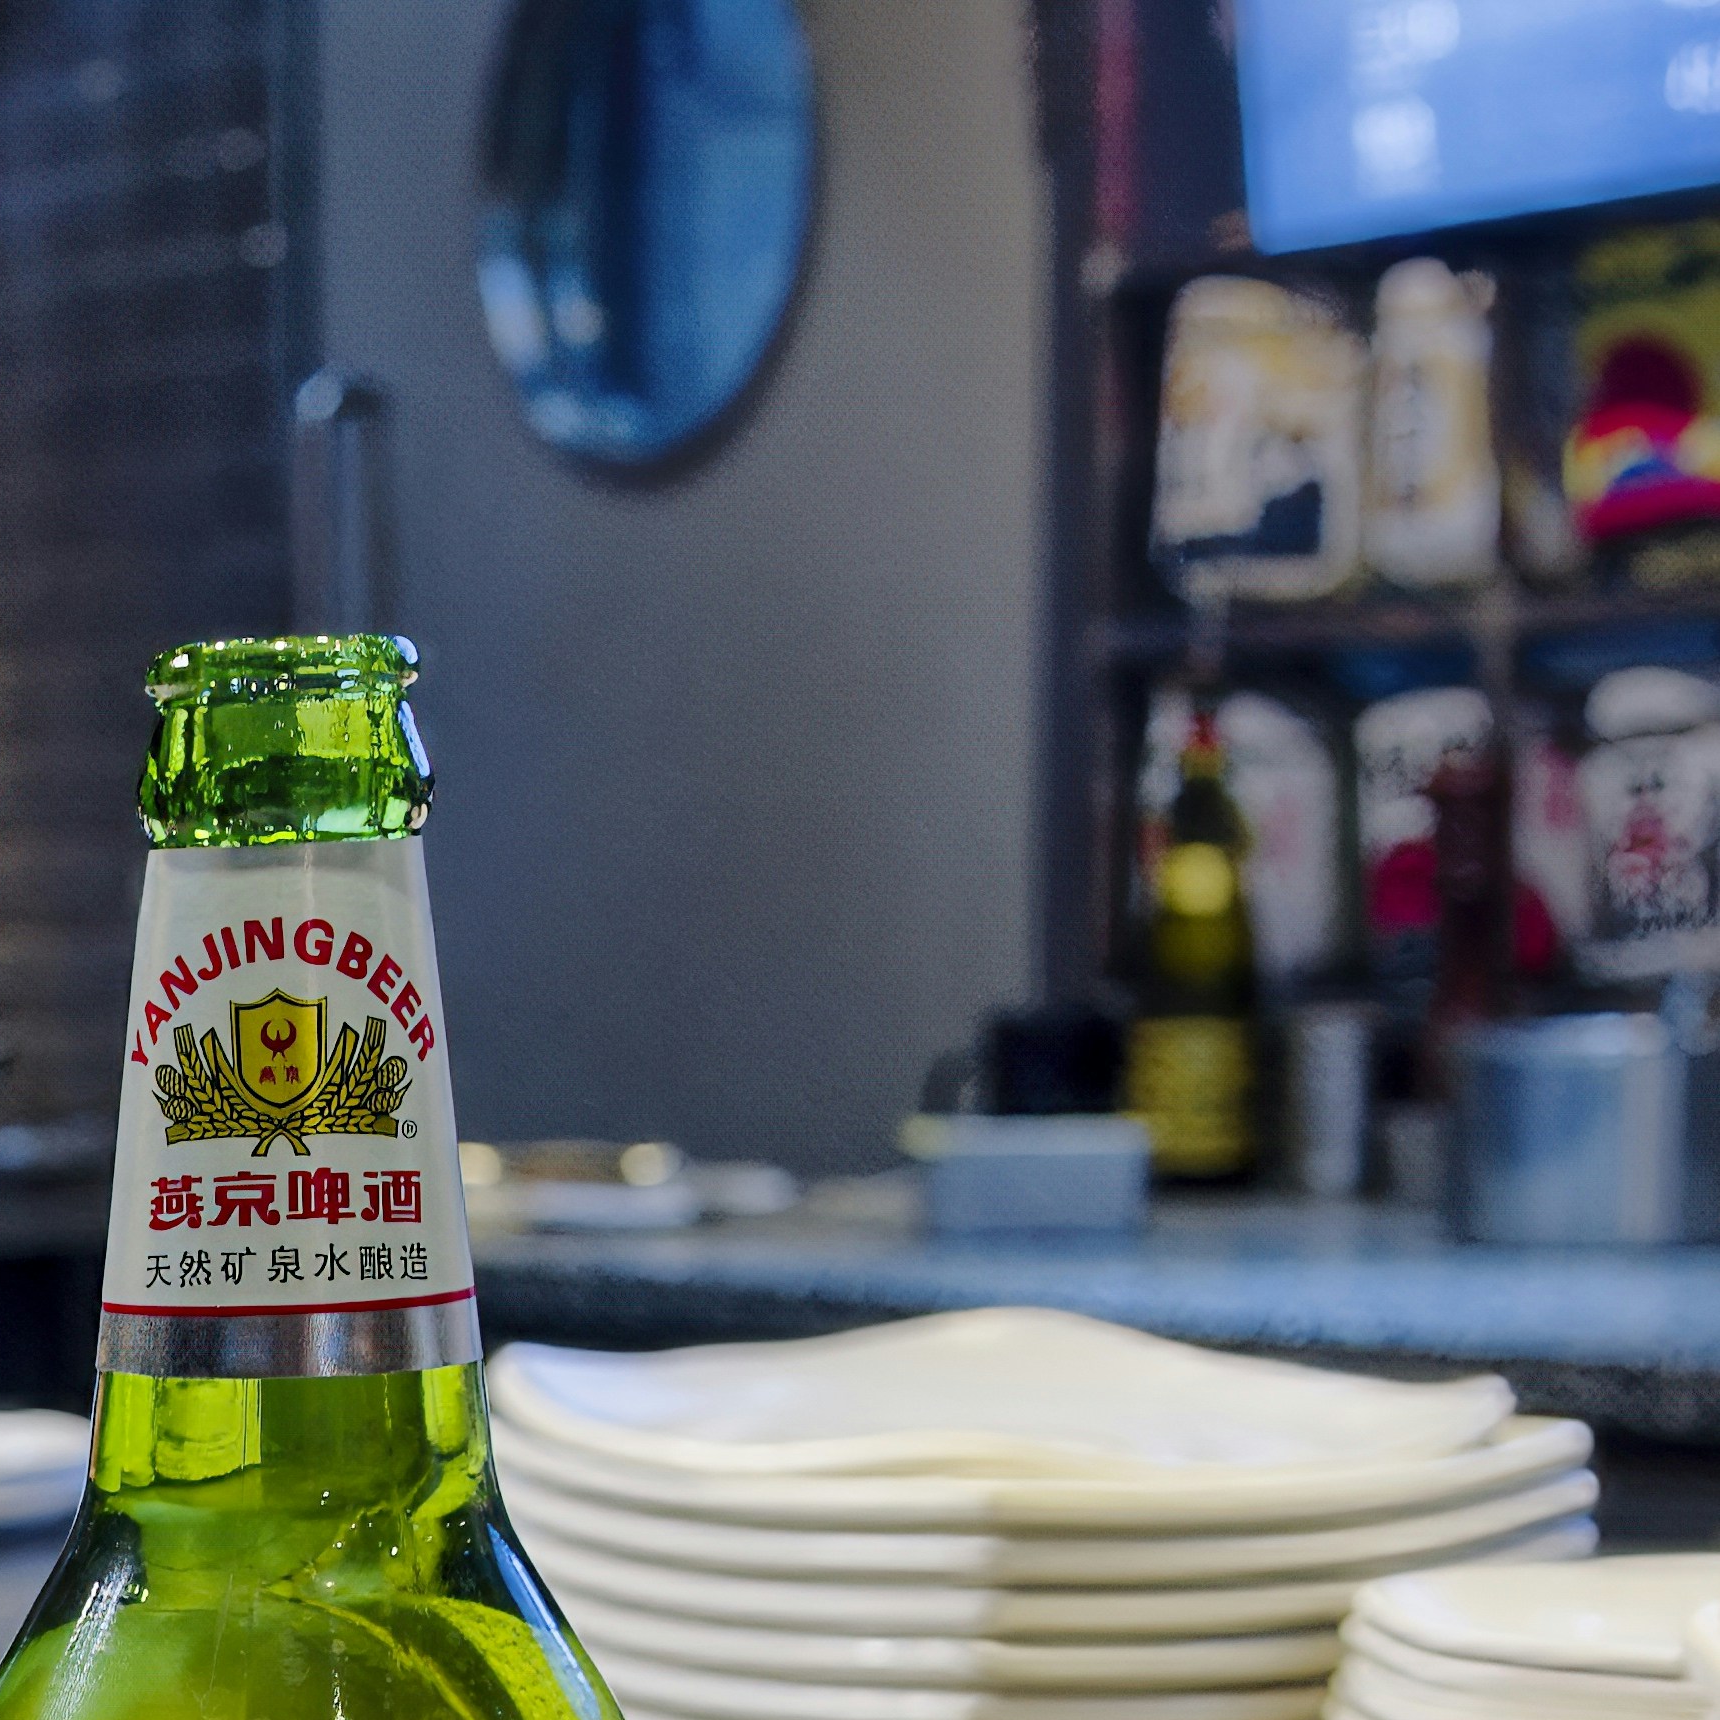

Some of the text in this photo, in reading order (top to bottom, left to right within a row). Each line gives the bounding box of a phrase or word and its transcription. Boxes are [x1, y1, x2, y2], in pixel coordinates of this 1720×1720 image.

[149, 1166, 423, 1230] 燕京啤酒
[145, 1242, 429, 1289] 天然矿泉水酿造
